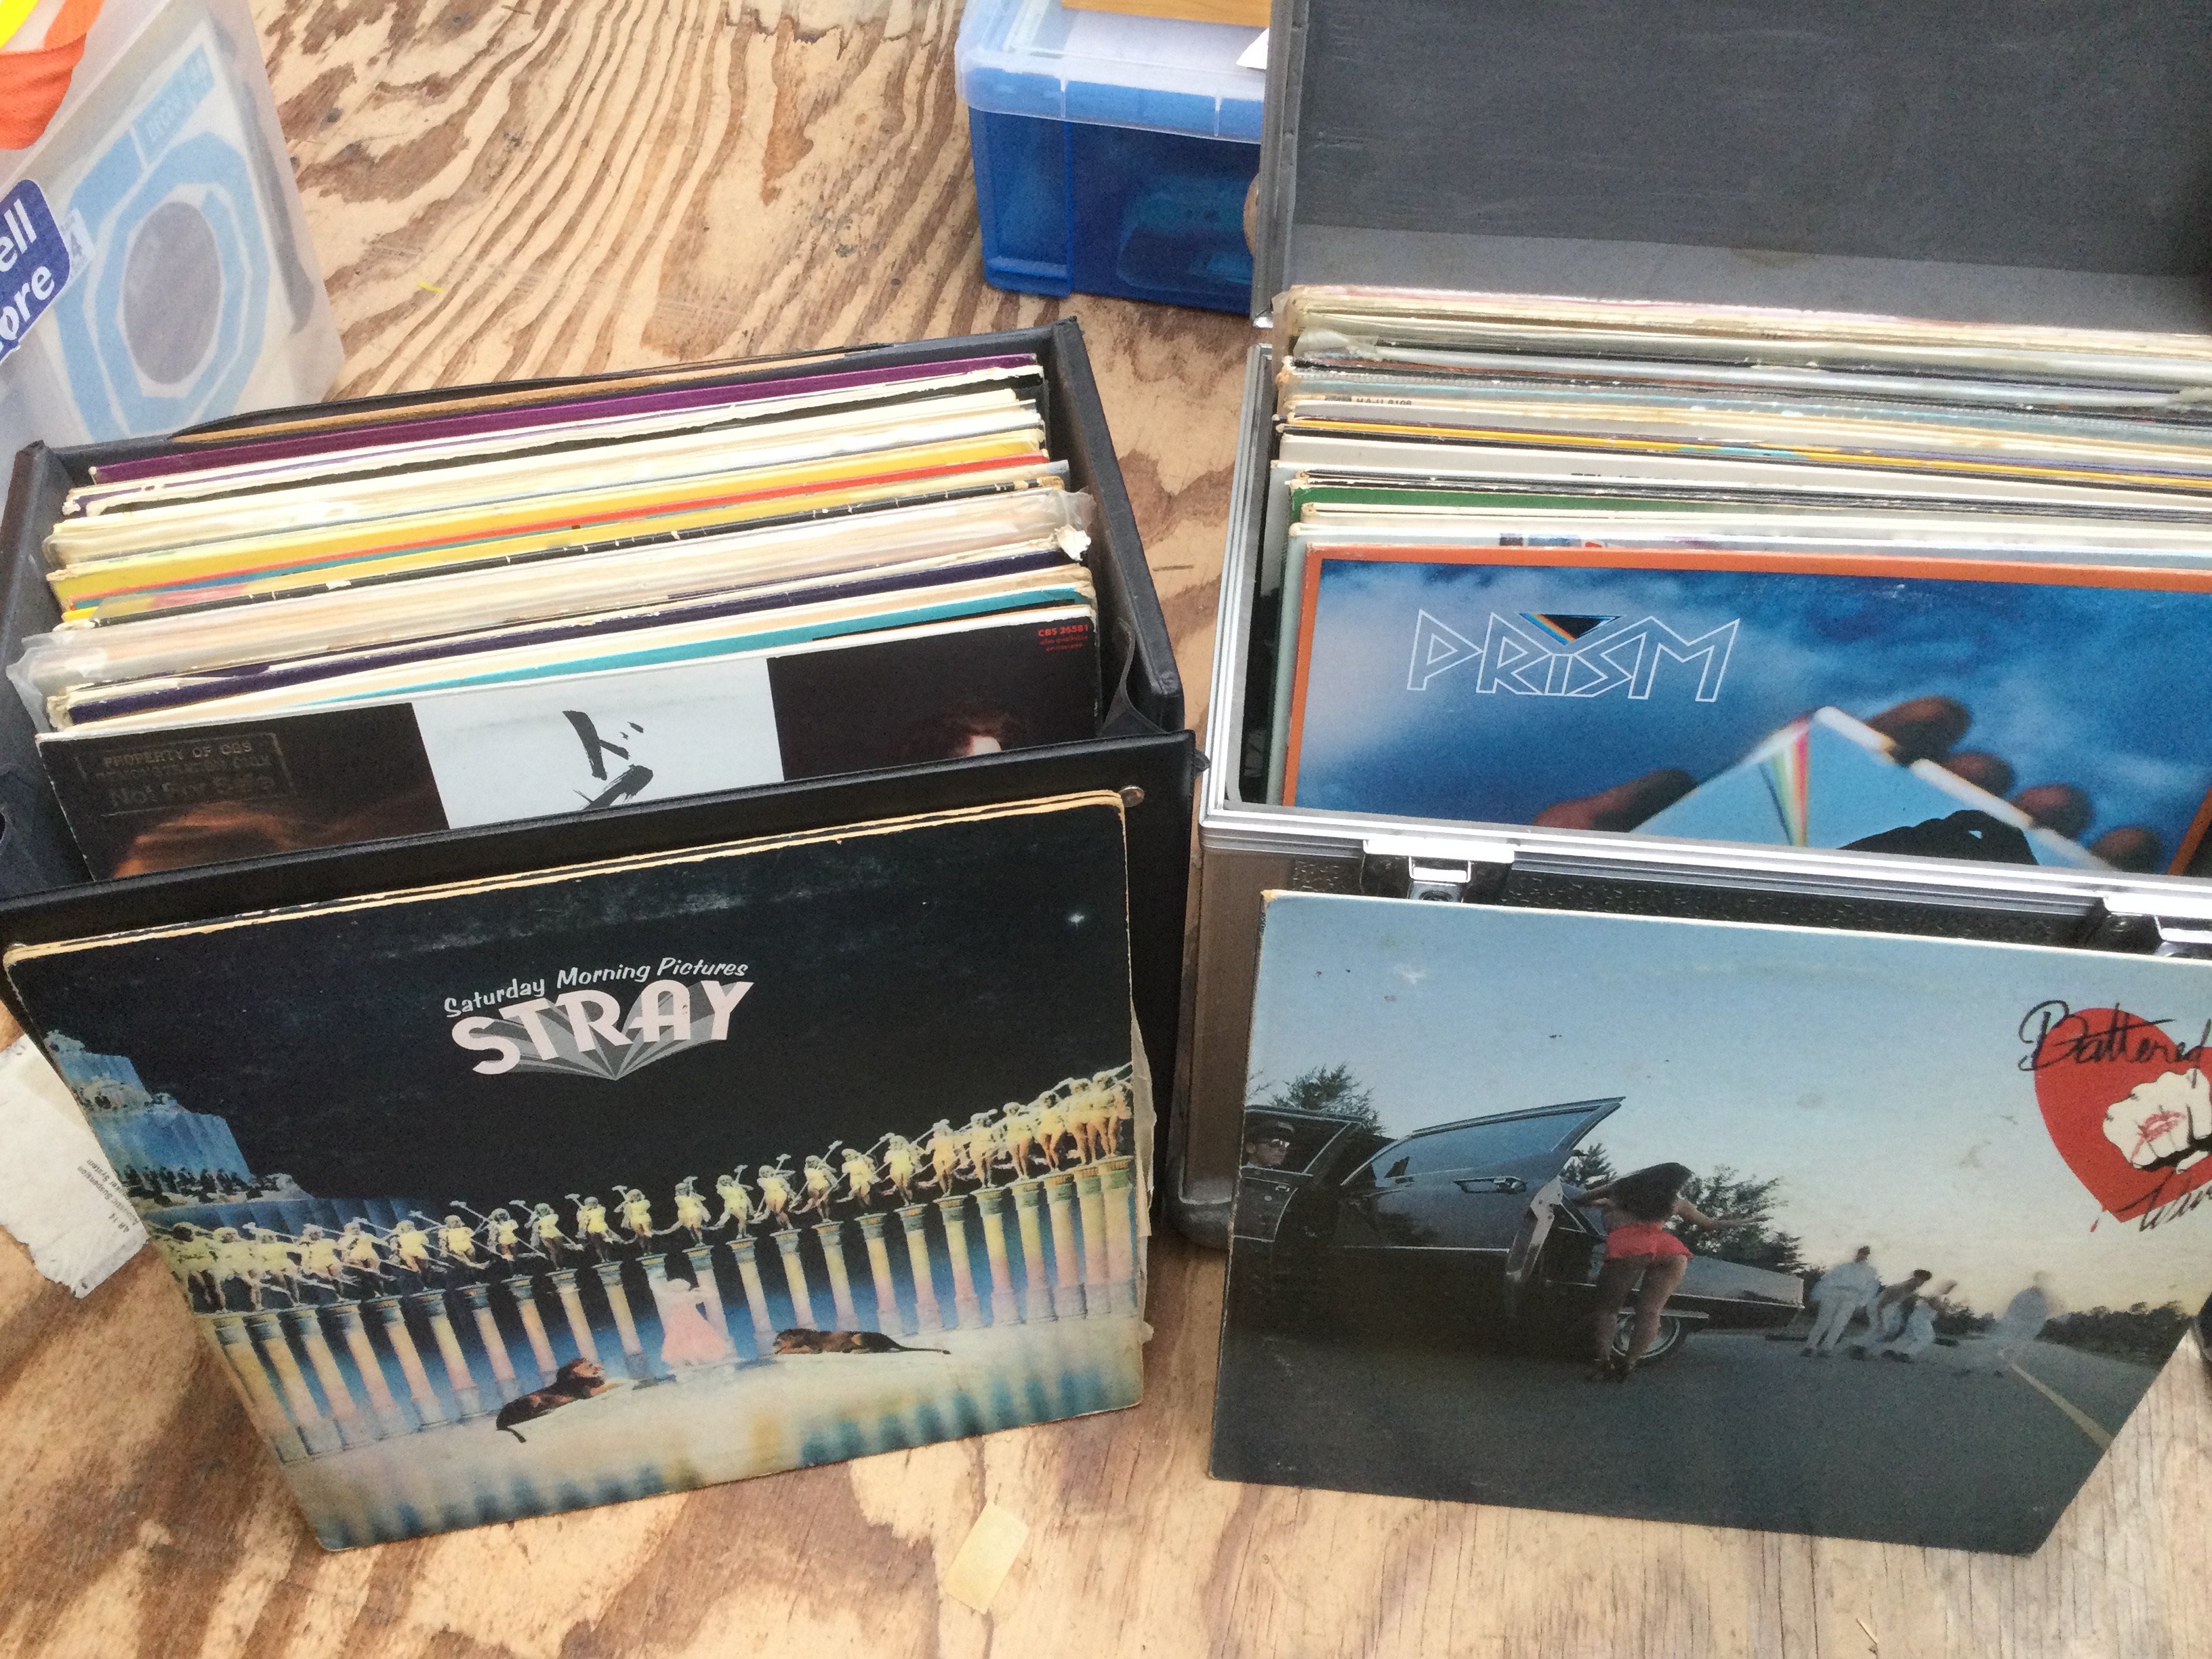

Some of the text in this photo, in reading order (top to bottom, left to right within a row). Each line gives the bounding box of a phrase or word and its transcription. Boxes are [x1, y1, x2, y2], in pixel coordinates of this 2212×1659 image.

[0, 265, 56, 351] ore
[1038, 628, 1057, 636] CBS
[1407, 609, 1740, 703] PRISM
[192, 745, 212, 758] OF
[444, 957, 748, 1018] Saturday Morning Pictures
[451, 979, 755, 1076] STRAY
